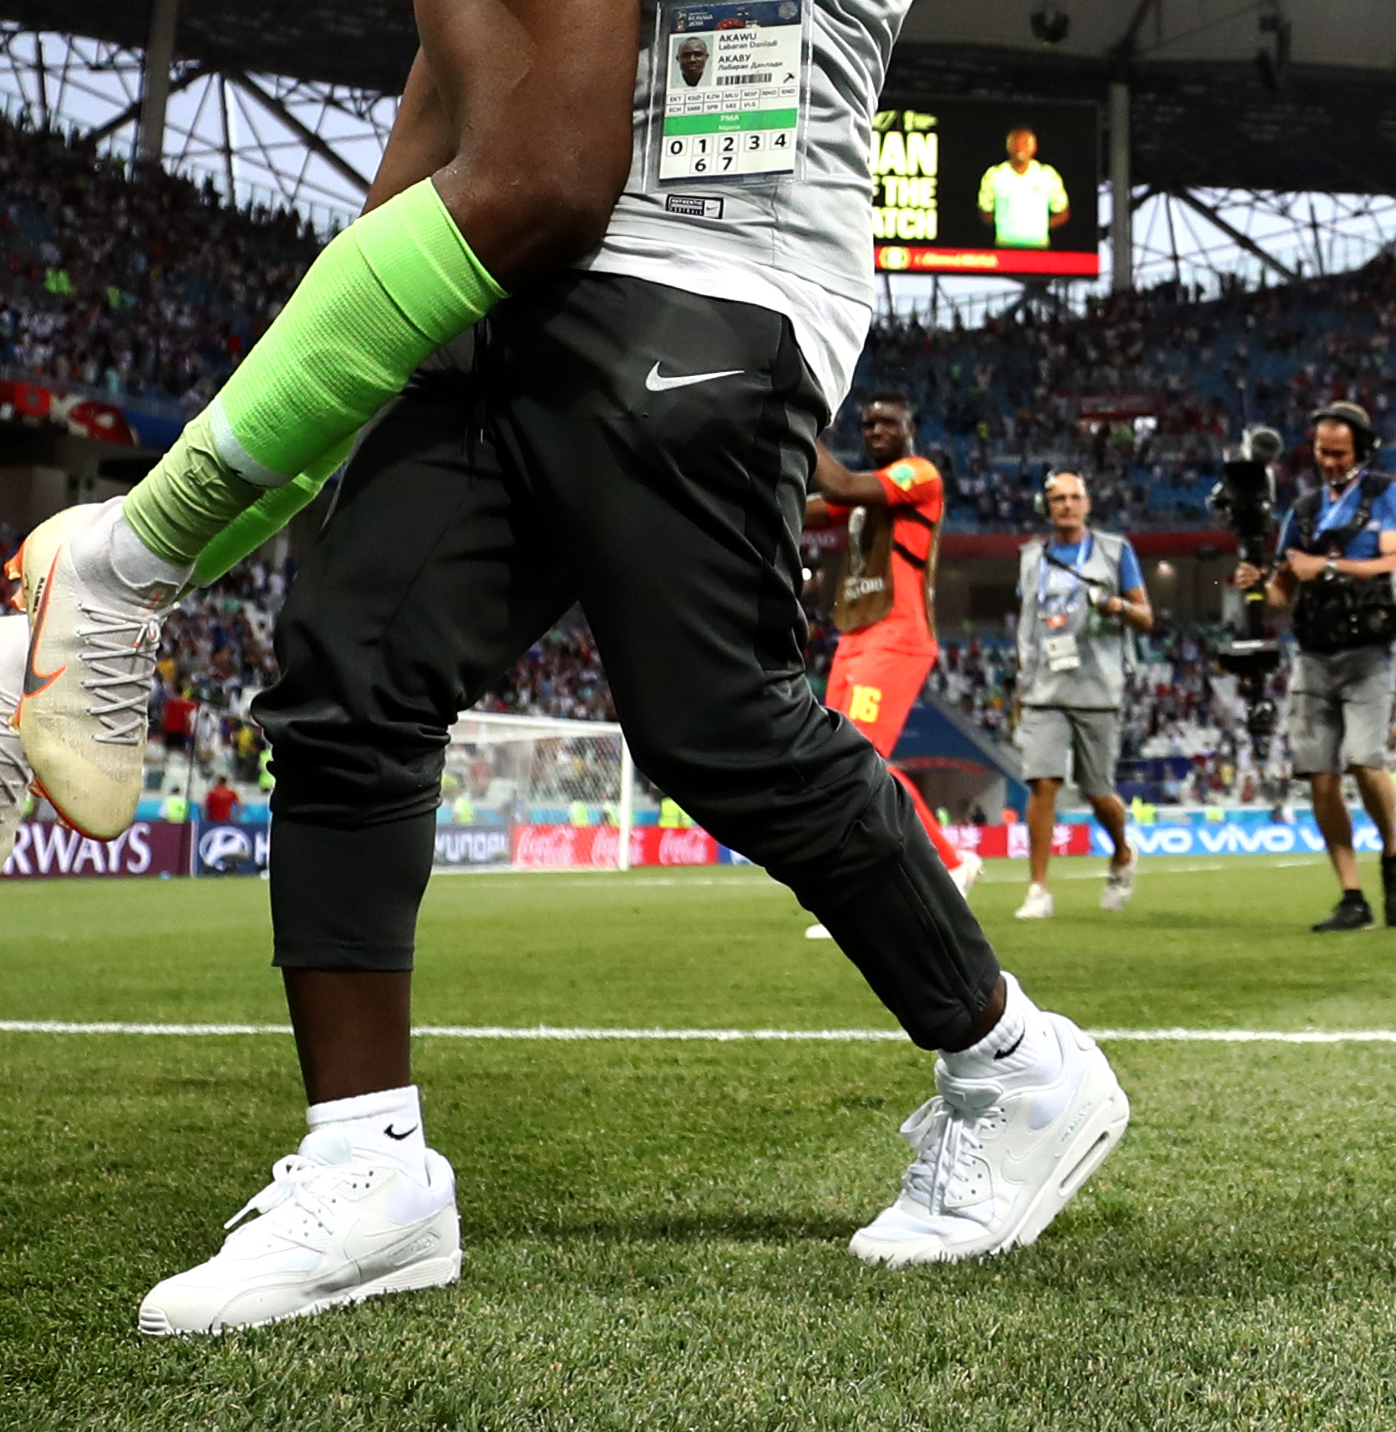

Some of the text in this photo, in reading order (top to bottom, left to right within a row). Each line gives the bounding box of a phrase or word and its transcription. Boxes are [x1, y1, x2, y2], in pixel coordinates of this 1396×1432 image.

[719, 33, 757, 43] AKAWU
[670, 133, 786, 155] 0 1 2 3 4
[871, 131, 939, 176] AN
[694, 156, 733, 172] 6 7
[882, 176, 938, 209] THE
[871, 206, 938, 241] ATCH
[849, 684, 882, 723] 16
[3, 822, 151, 875] RWAYS
[435, 832, 508, 861] YUNDAI
[1096, 825, 1194, 853] vvo
